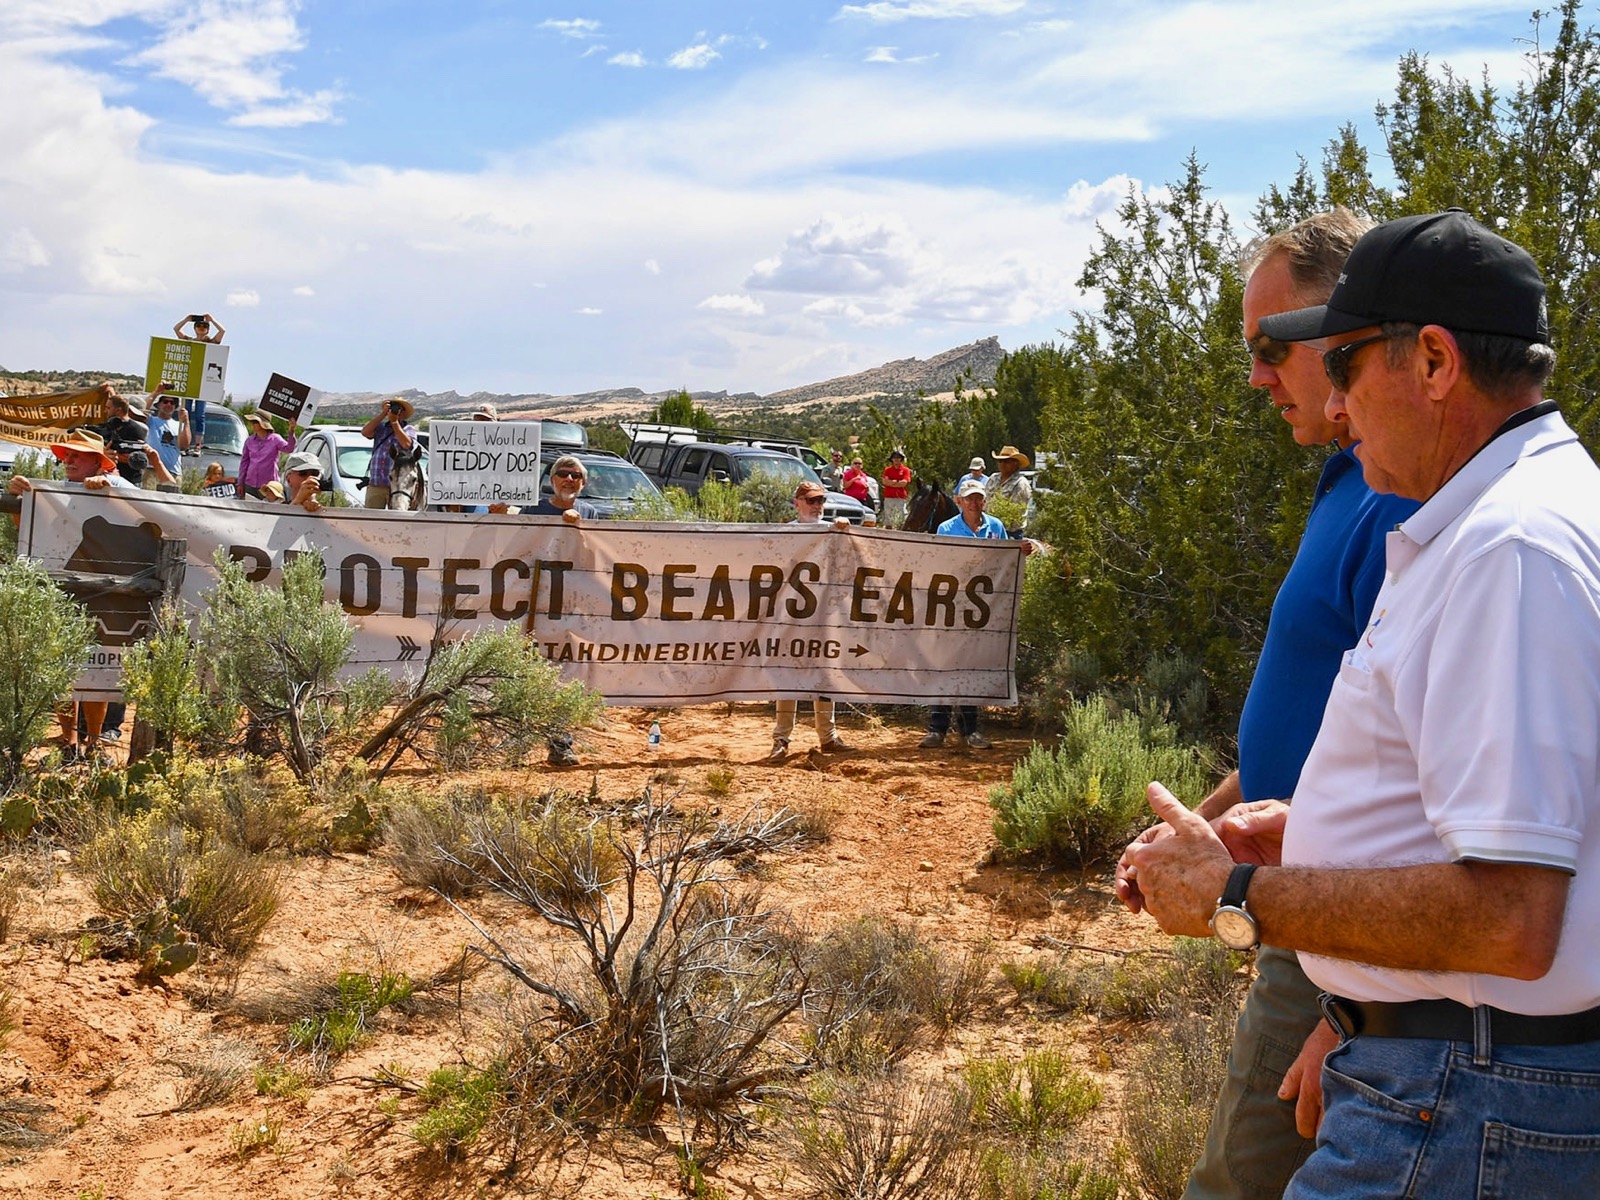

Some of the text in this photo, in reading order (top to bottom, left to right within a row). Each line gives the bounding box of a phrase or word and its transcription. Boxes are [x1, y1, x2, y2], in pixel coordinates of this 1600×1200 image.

[165, 343, 191, 354] HONOR
[161, 370, 188, 382] BEARS
[163, 361, 189, 373] HONOR
[267, 388, 302, 407] STANDS WITH
[283, 402, 296, 411] EARS
[49, 402, 102, 420] BIKÉYAH
[435, 425, 527, 447] What Would
[436, 449, 537, 473] TEDDY DO?
[431, 480, 456, 501] San
[456, 481, 478, 500] Juan
[492, 483, 533, 501] Resident
[611, 561, 994, 629] BEARS EARS
